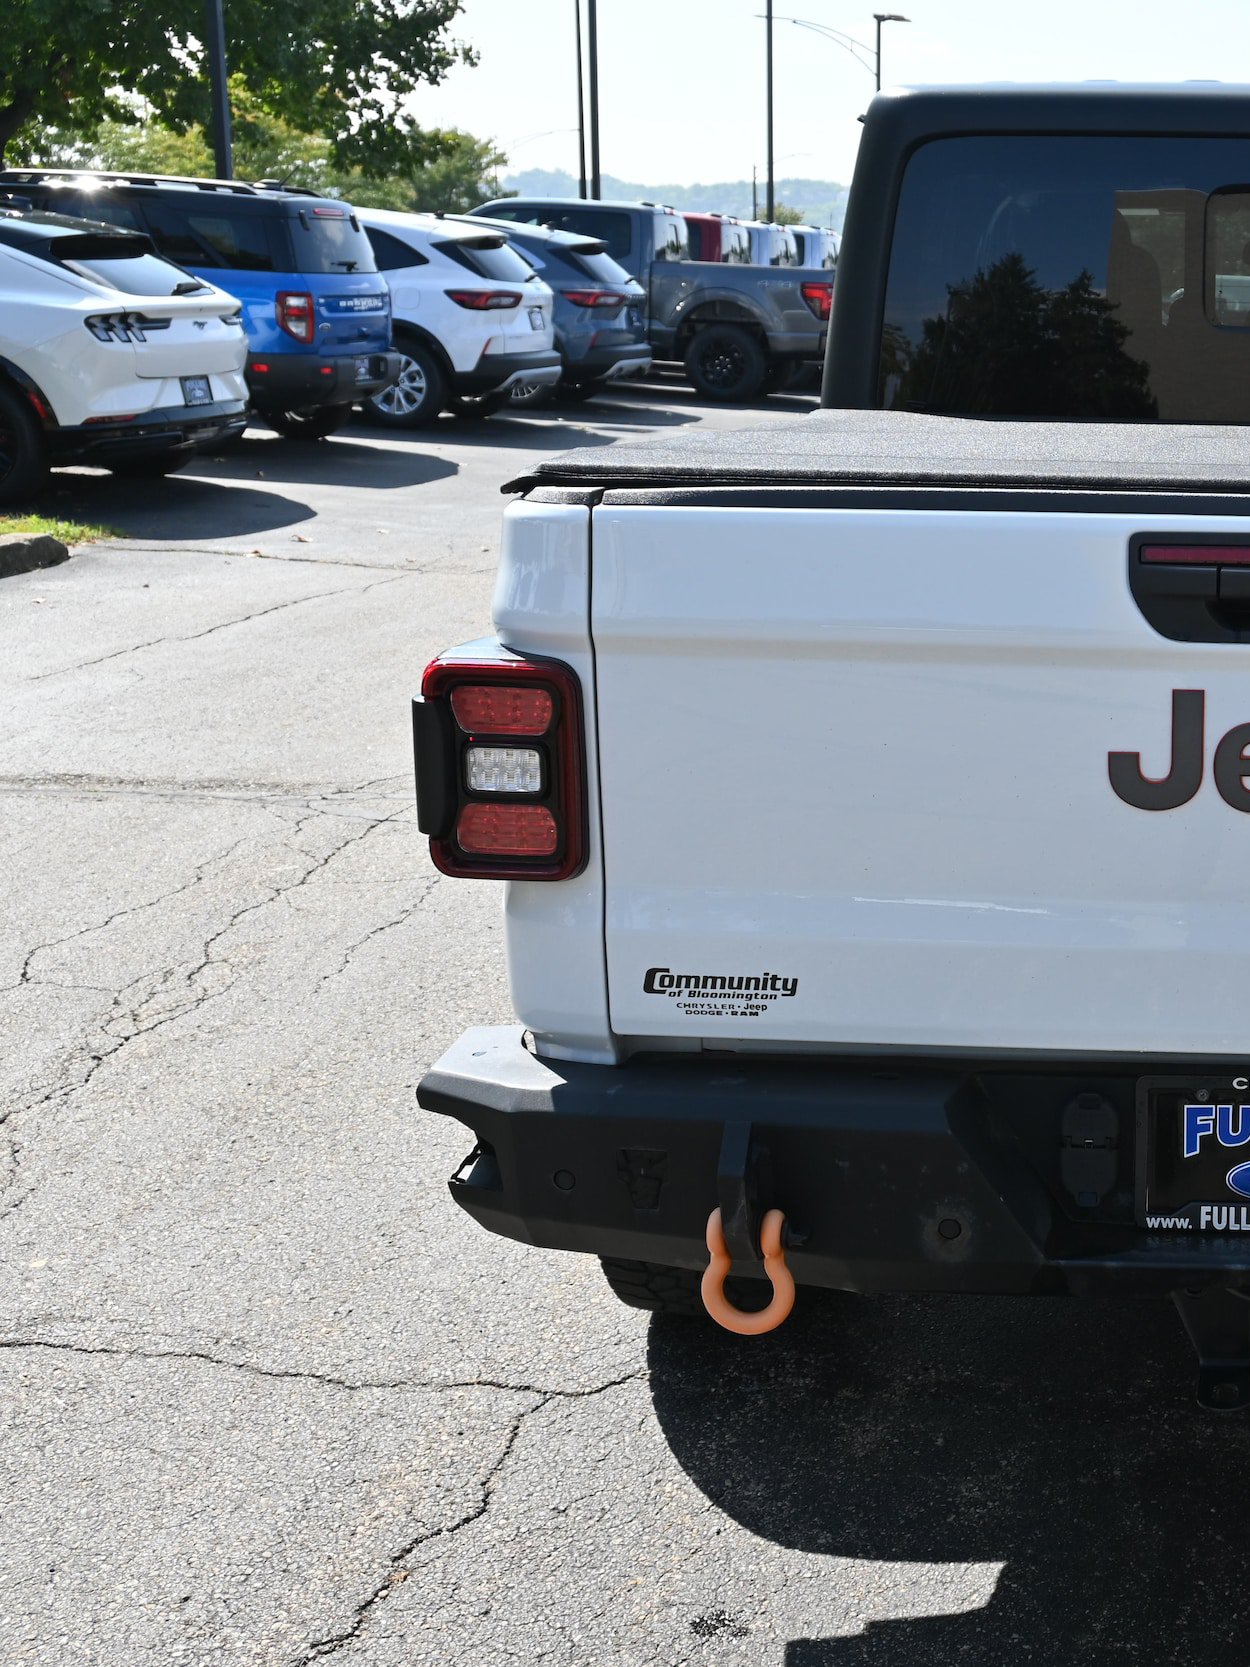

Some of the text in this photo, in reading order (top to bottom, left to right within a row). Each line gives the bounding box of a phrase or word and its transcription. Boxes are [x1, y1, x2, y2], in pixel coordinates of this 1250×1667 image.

[643, 967, 798, 997] Community
[668, 989, 778, 1002] of Bloomington
[676, 1002, 768, 1012] CHRYSLER Jeep
[1146, 1216, 1193, 1230] www.
